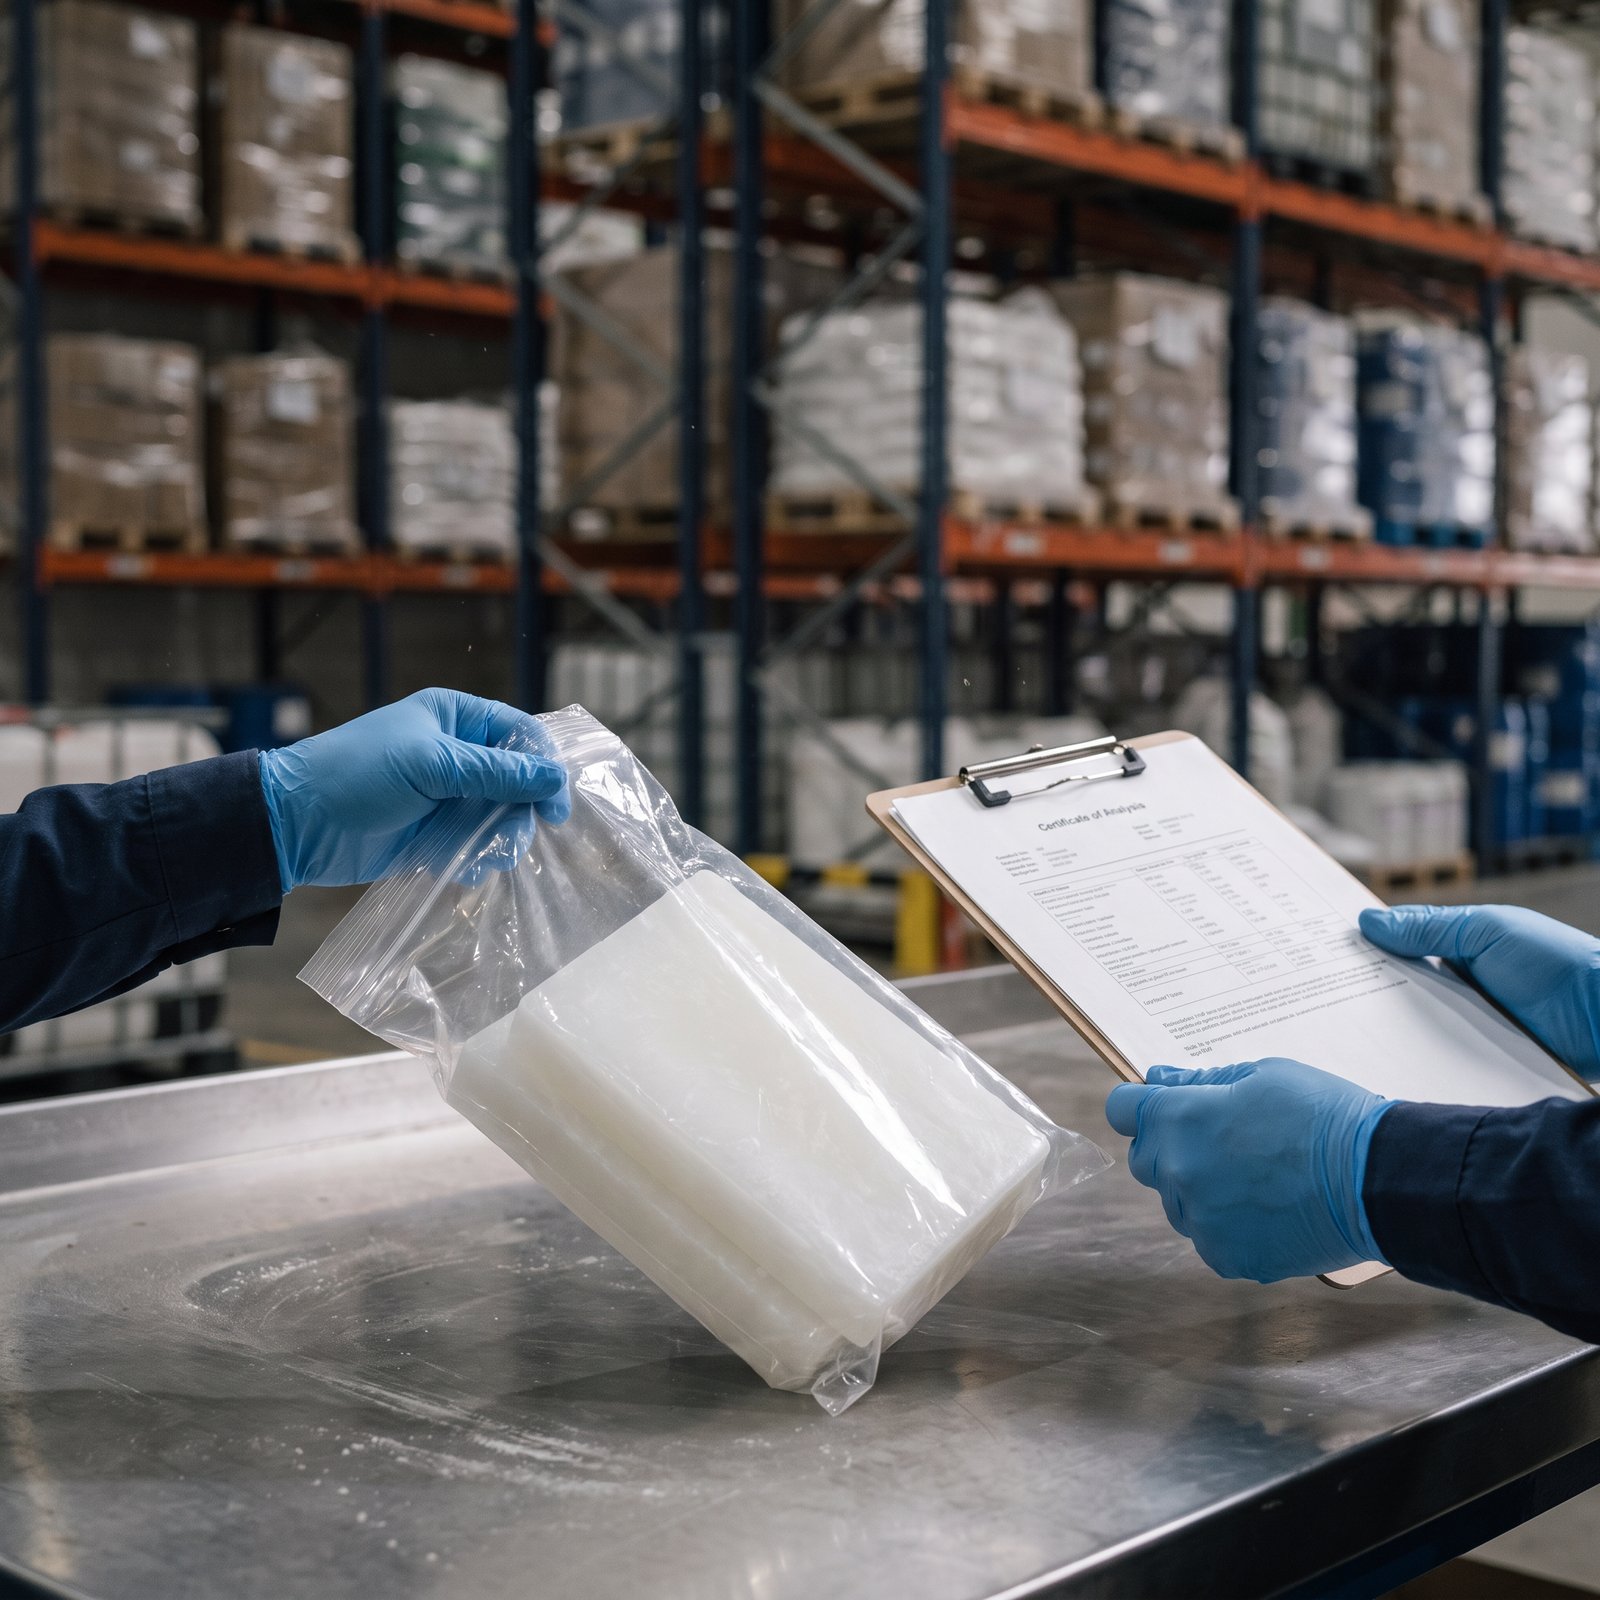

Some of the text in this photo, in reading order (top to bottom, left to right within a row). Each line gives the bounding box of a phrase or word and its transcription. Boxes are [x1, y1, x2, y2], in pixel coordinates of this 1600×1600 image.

[1038, 802, 1146, 831] Certificate of Analysis
